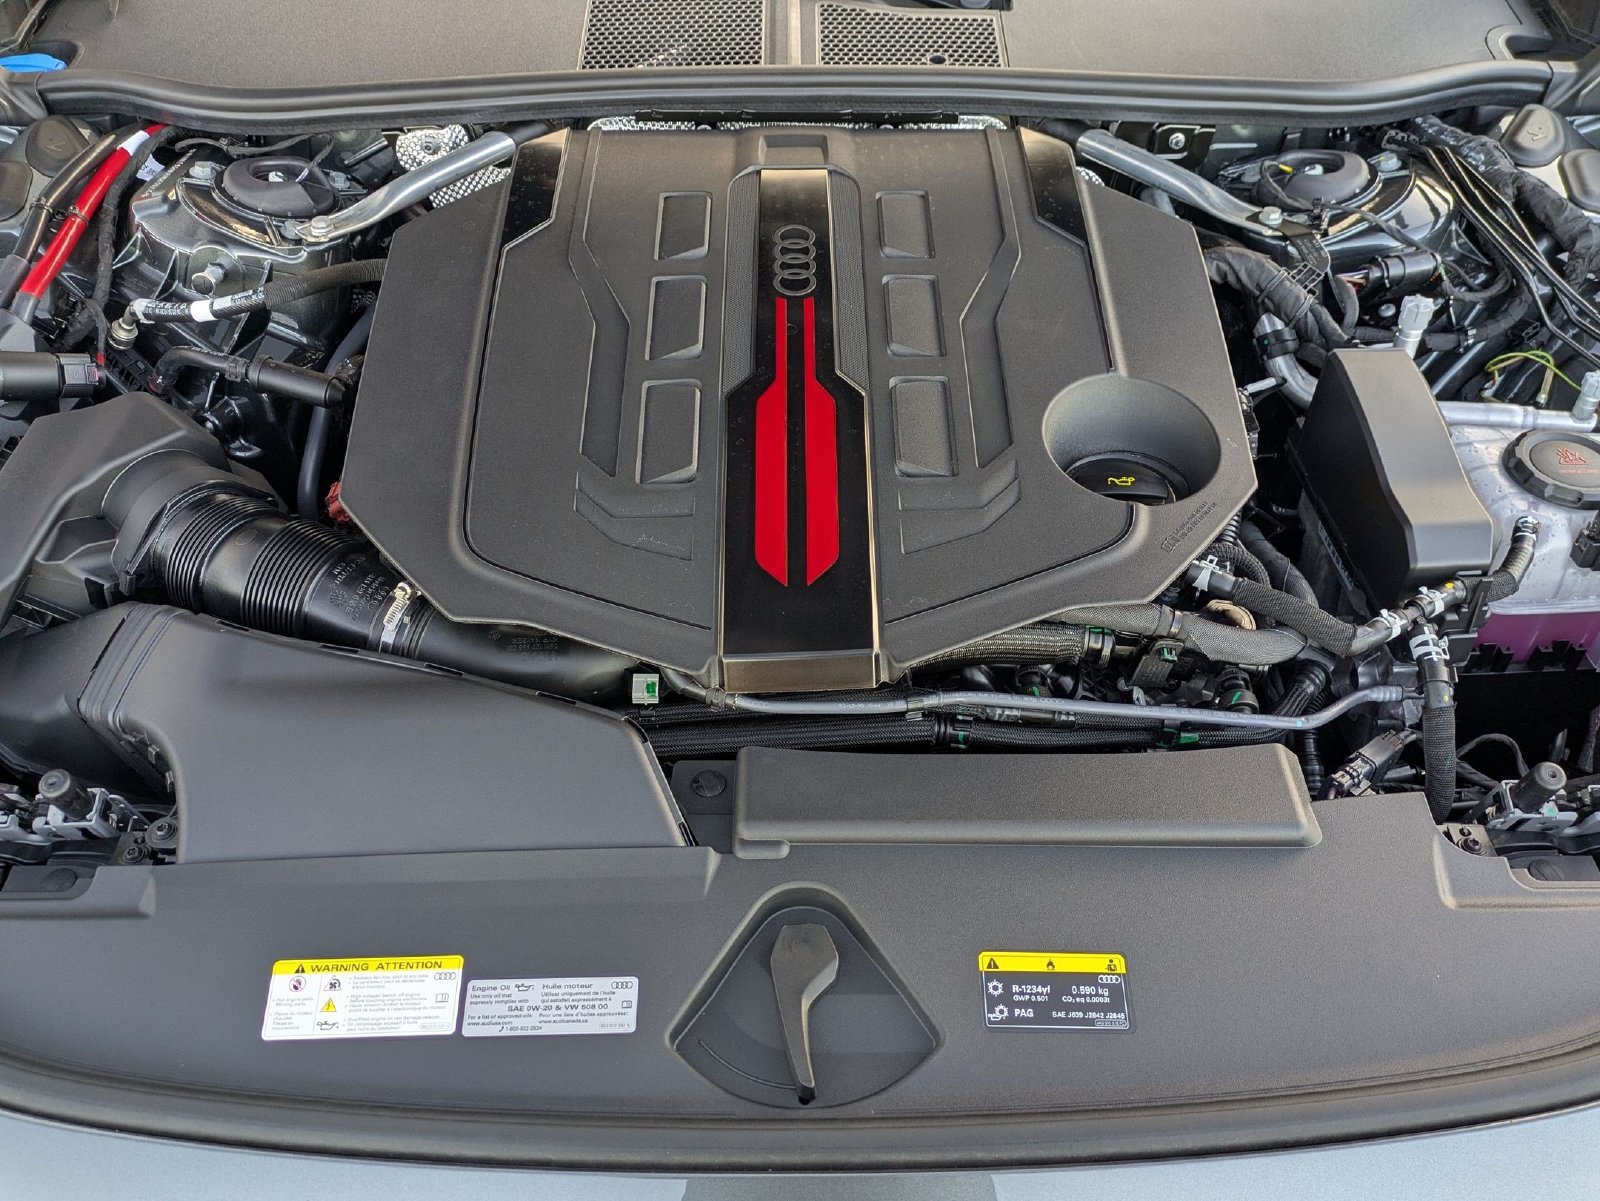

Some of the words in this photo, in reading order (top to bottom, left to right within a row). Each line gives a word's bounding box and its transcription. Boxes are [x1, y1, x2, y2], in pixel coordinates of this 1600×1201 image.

[310, 962, 369, 972] WARNING
[376, 961, 442, 970] ATTENTION
[1012, 985, 1050, 994] R-1234yf
[1071, 986, 1096, 994] 0.590
[1098, 986, 1109, 996] kg
[1014, 1009, 1034, 1017] PAG
